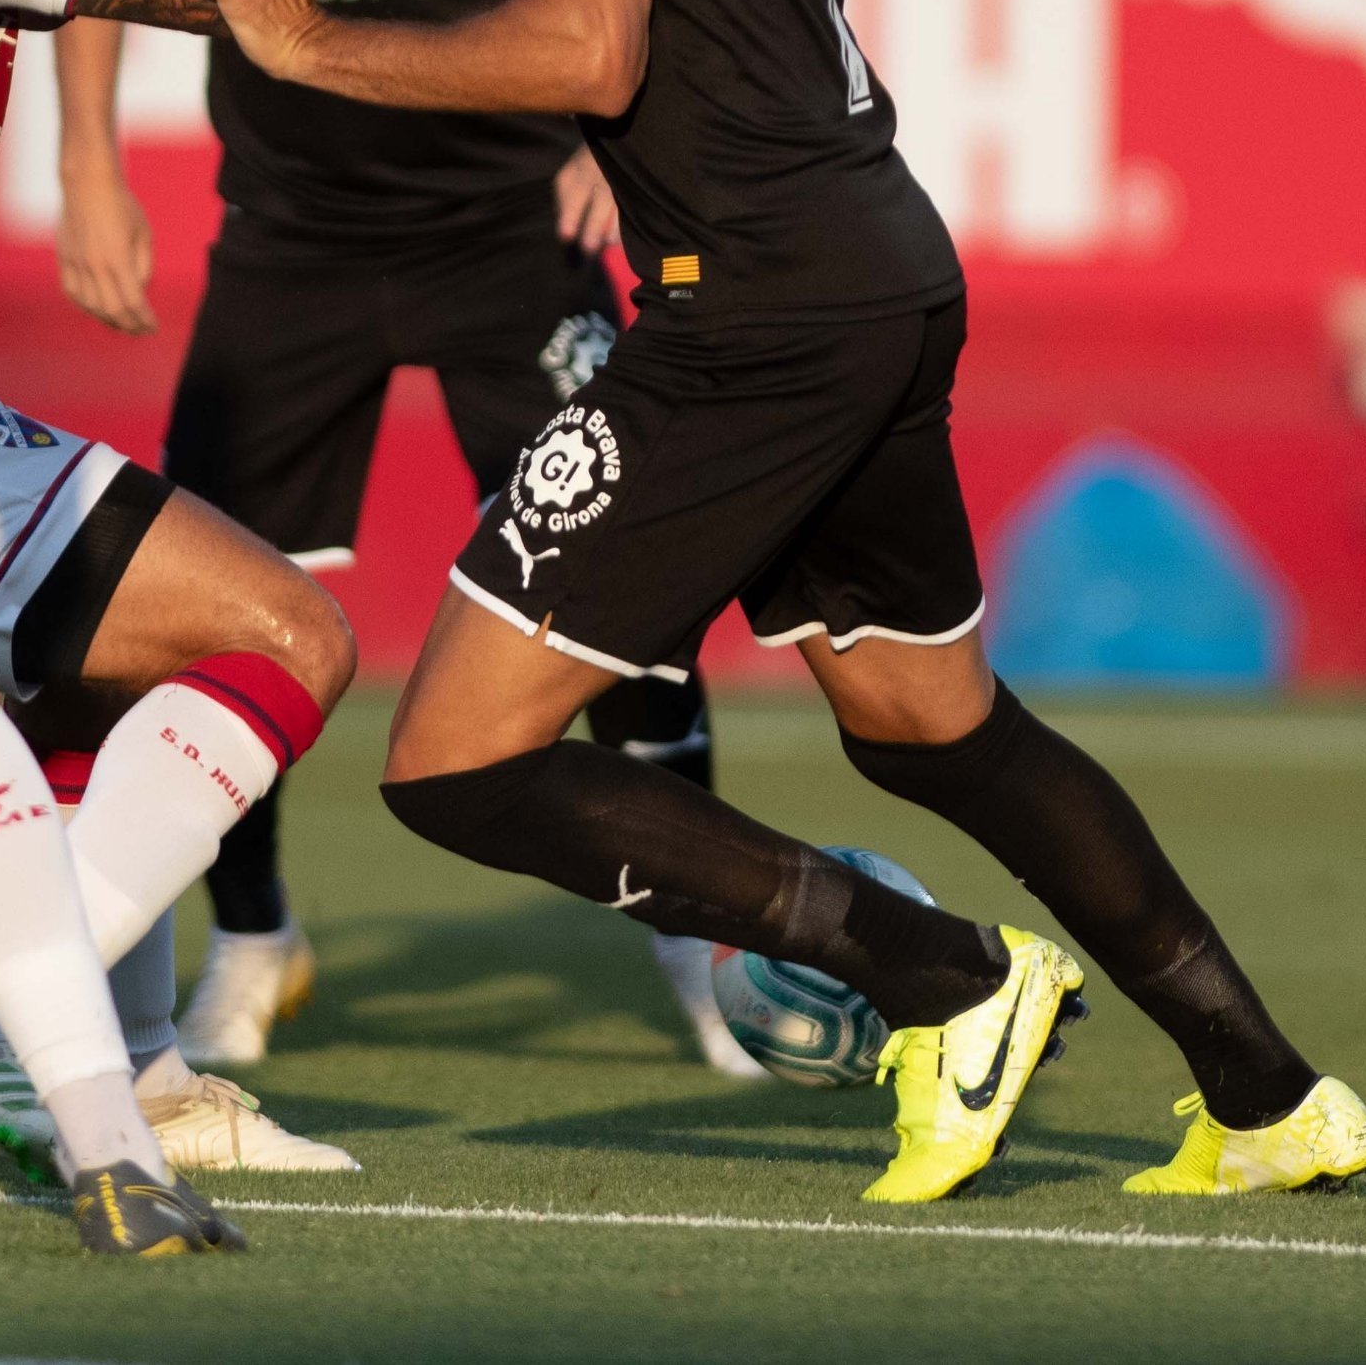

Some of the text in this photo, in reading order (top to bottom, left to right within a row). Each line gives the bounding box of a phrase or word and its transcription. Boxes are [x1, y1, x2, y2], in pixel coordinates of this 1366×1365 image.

[535, 403, 621, 482] Costa Brava
[521, 506, 542, 529] de
[547, 490, 612, 533] Girona
[209, 767, 250, 820] HUE
